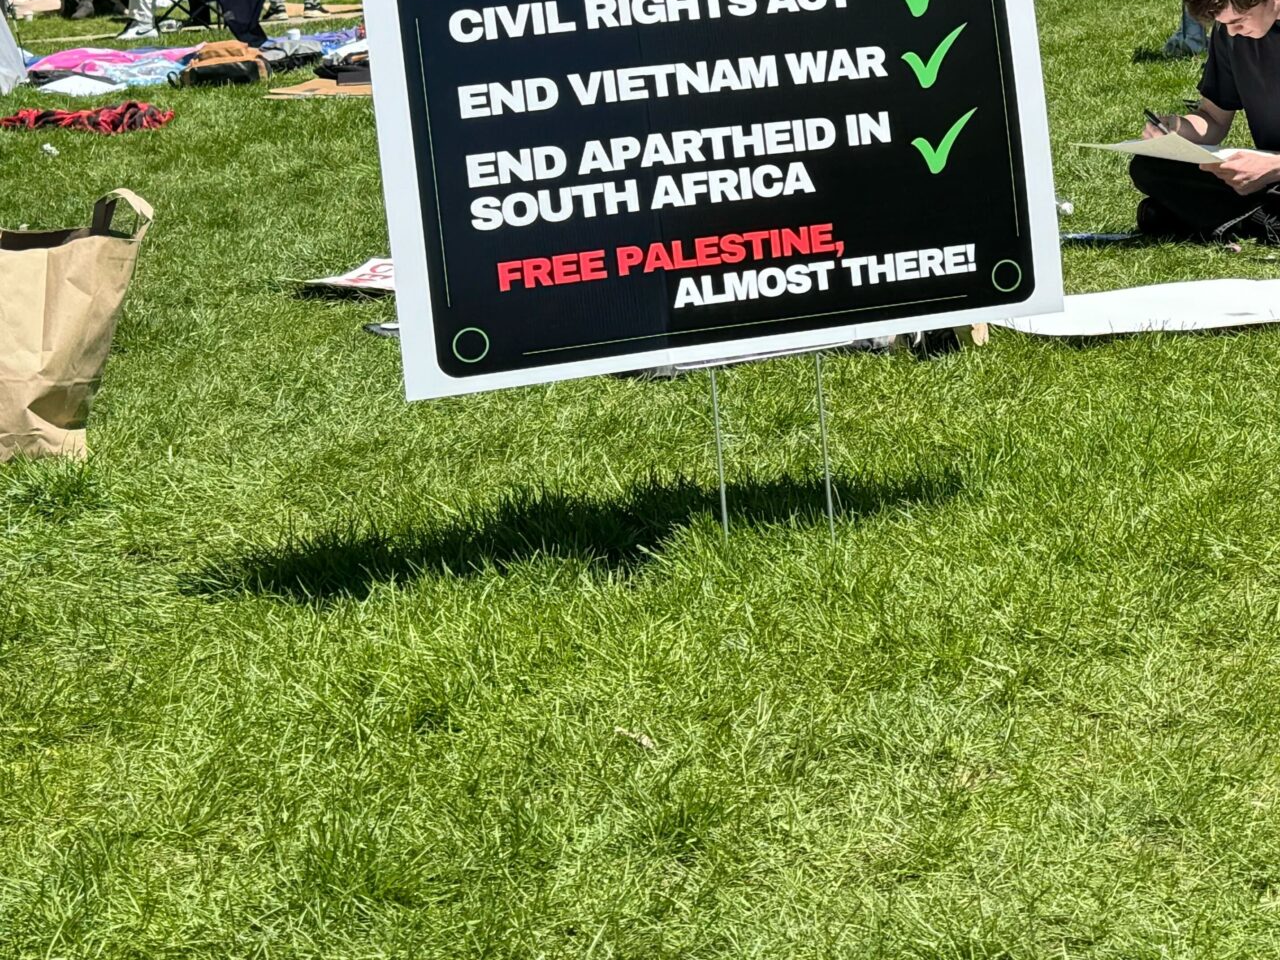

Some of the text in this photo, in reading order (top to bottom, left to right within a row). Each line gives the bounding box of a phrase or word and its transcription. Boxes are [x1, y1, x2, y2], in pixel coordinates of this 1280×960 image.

[448, 0, 577, 43] CIVIL
[458, 46, 888, 119] END VIETNAM WAR
[466, 111, 892, 189] END APARTHEID IN
[470, 161, 817, 231] SOUTH AFRICA
[497, 223, 845, 292] FREE PALESTINE,
[673, 244, 977, 309] ALMOST THERE!
